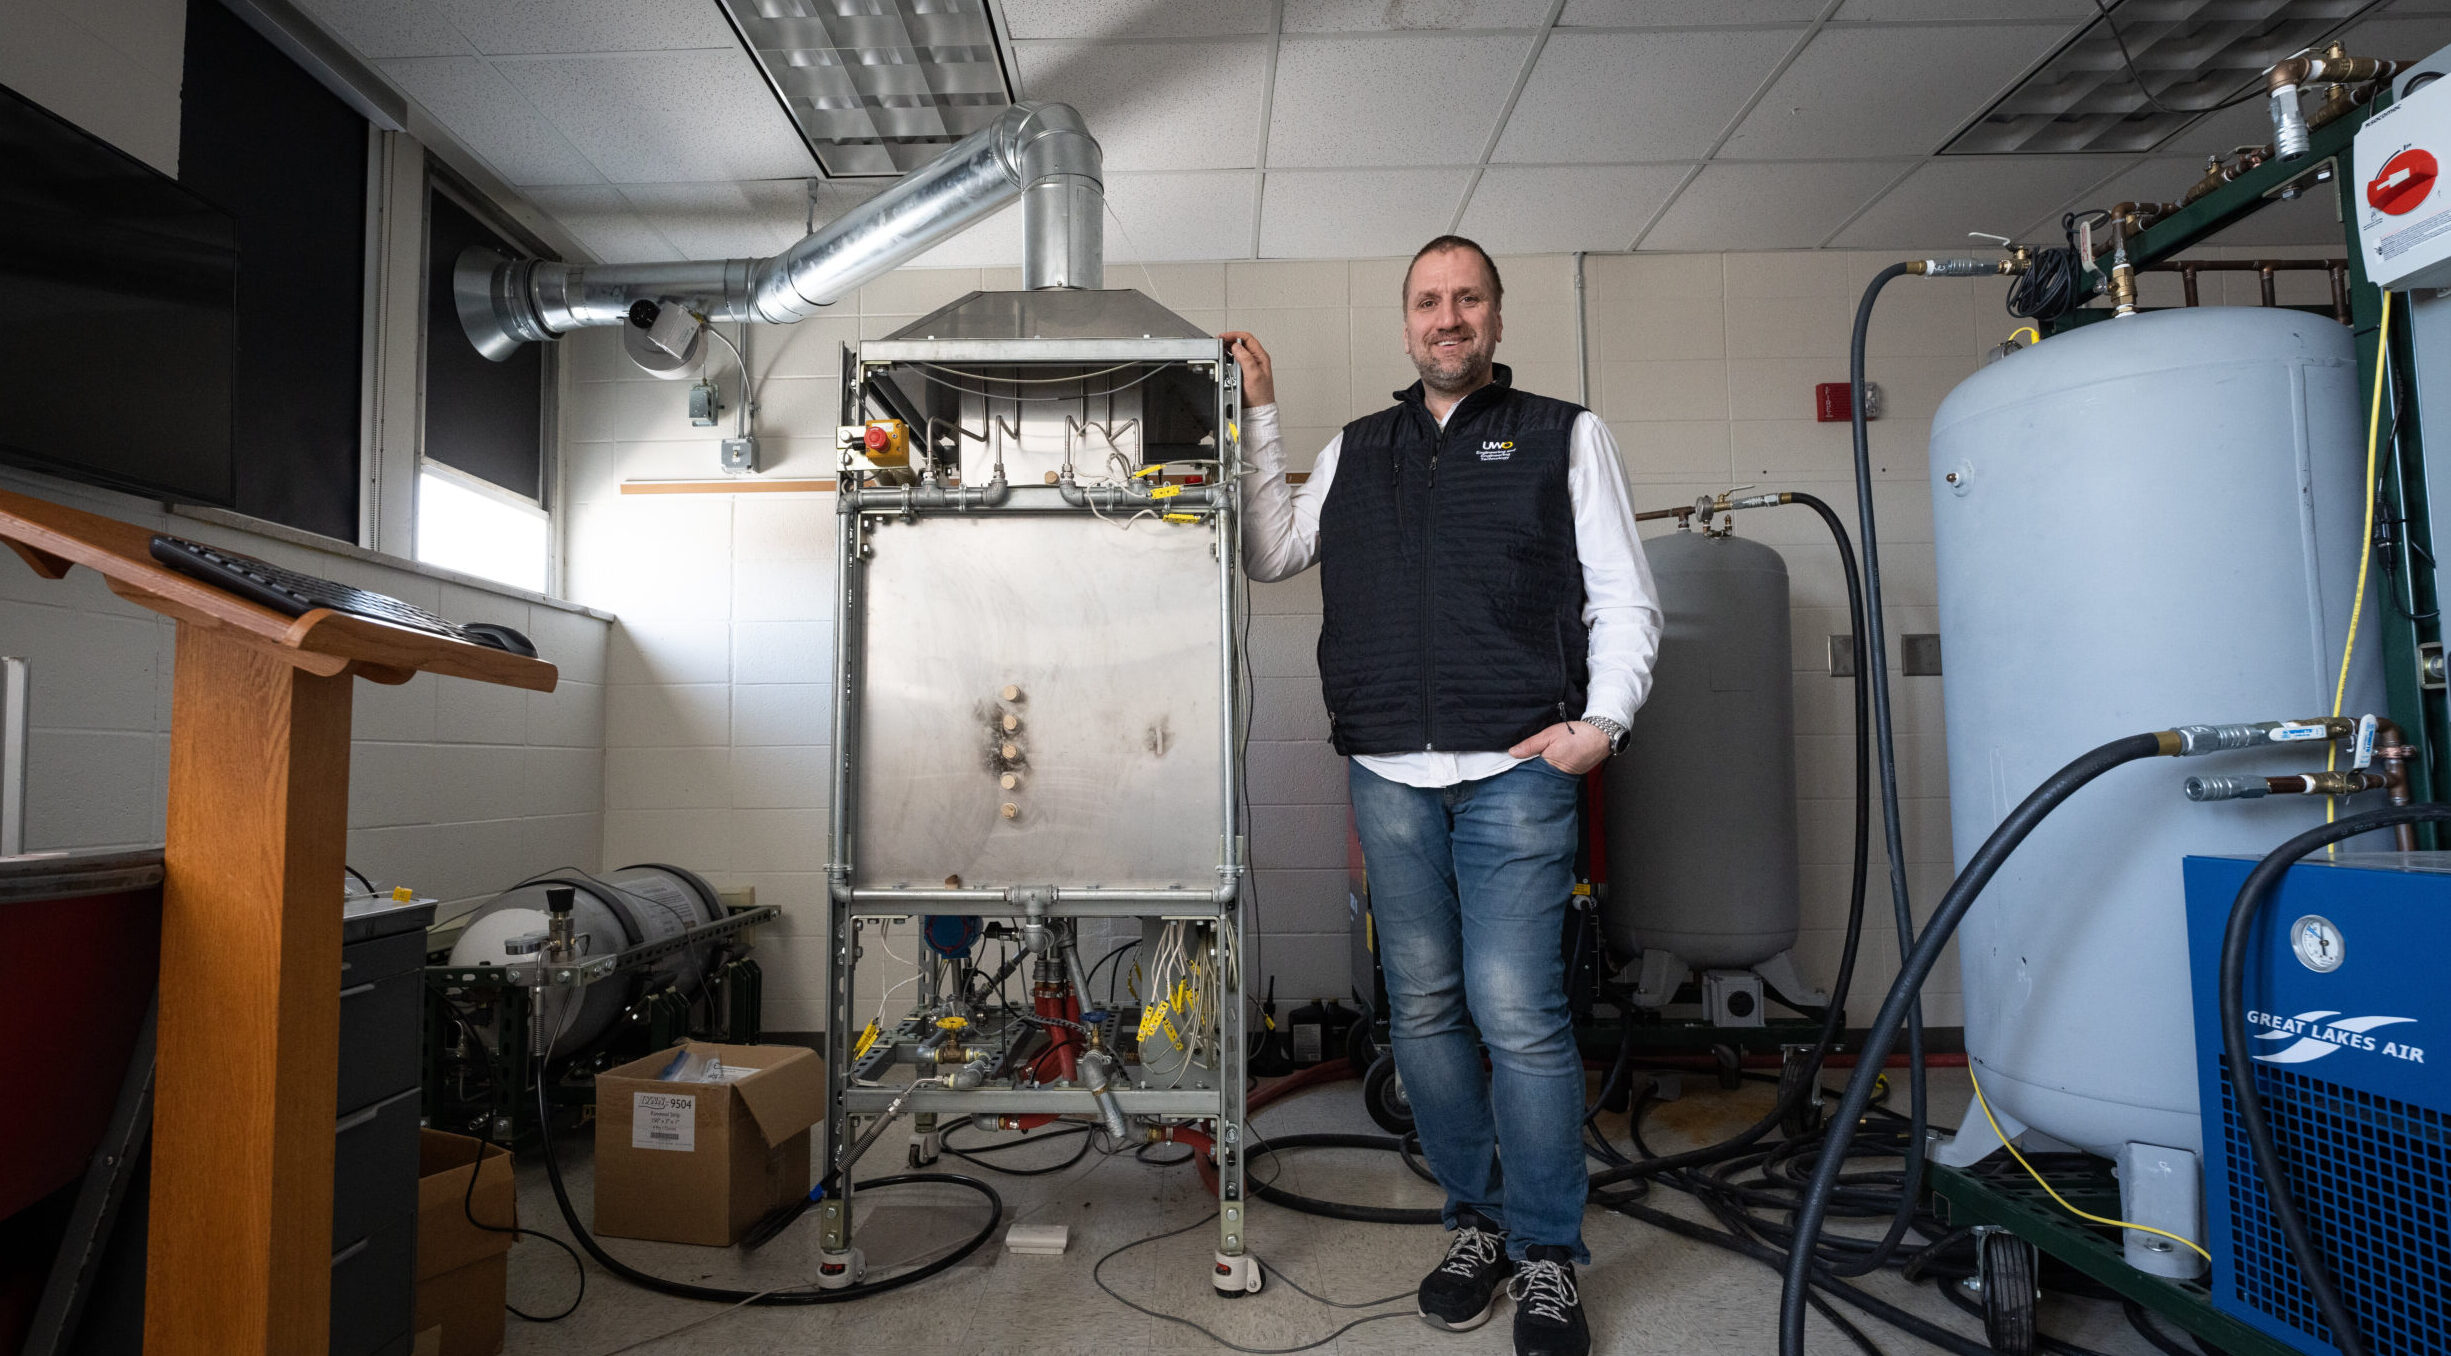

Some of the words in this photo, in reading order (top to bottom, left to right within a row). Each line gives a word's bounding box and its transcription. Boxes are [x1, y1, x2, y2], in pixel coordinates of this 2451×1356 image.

[1482, 440, 1513, 450] UWO
[2246, 1010, 2306, 1034] GREAT
[2311, 1024, 2376, 1051] LAKES
[2382, 1041, 2425, 1064] AIR
[670, 1098, 692, 1110] 9504
